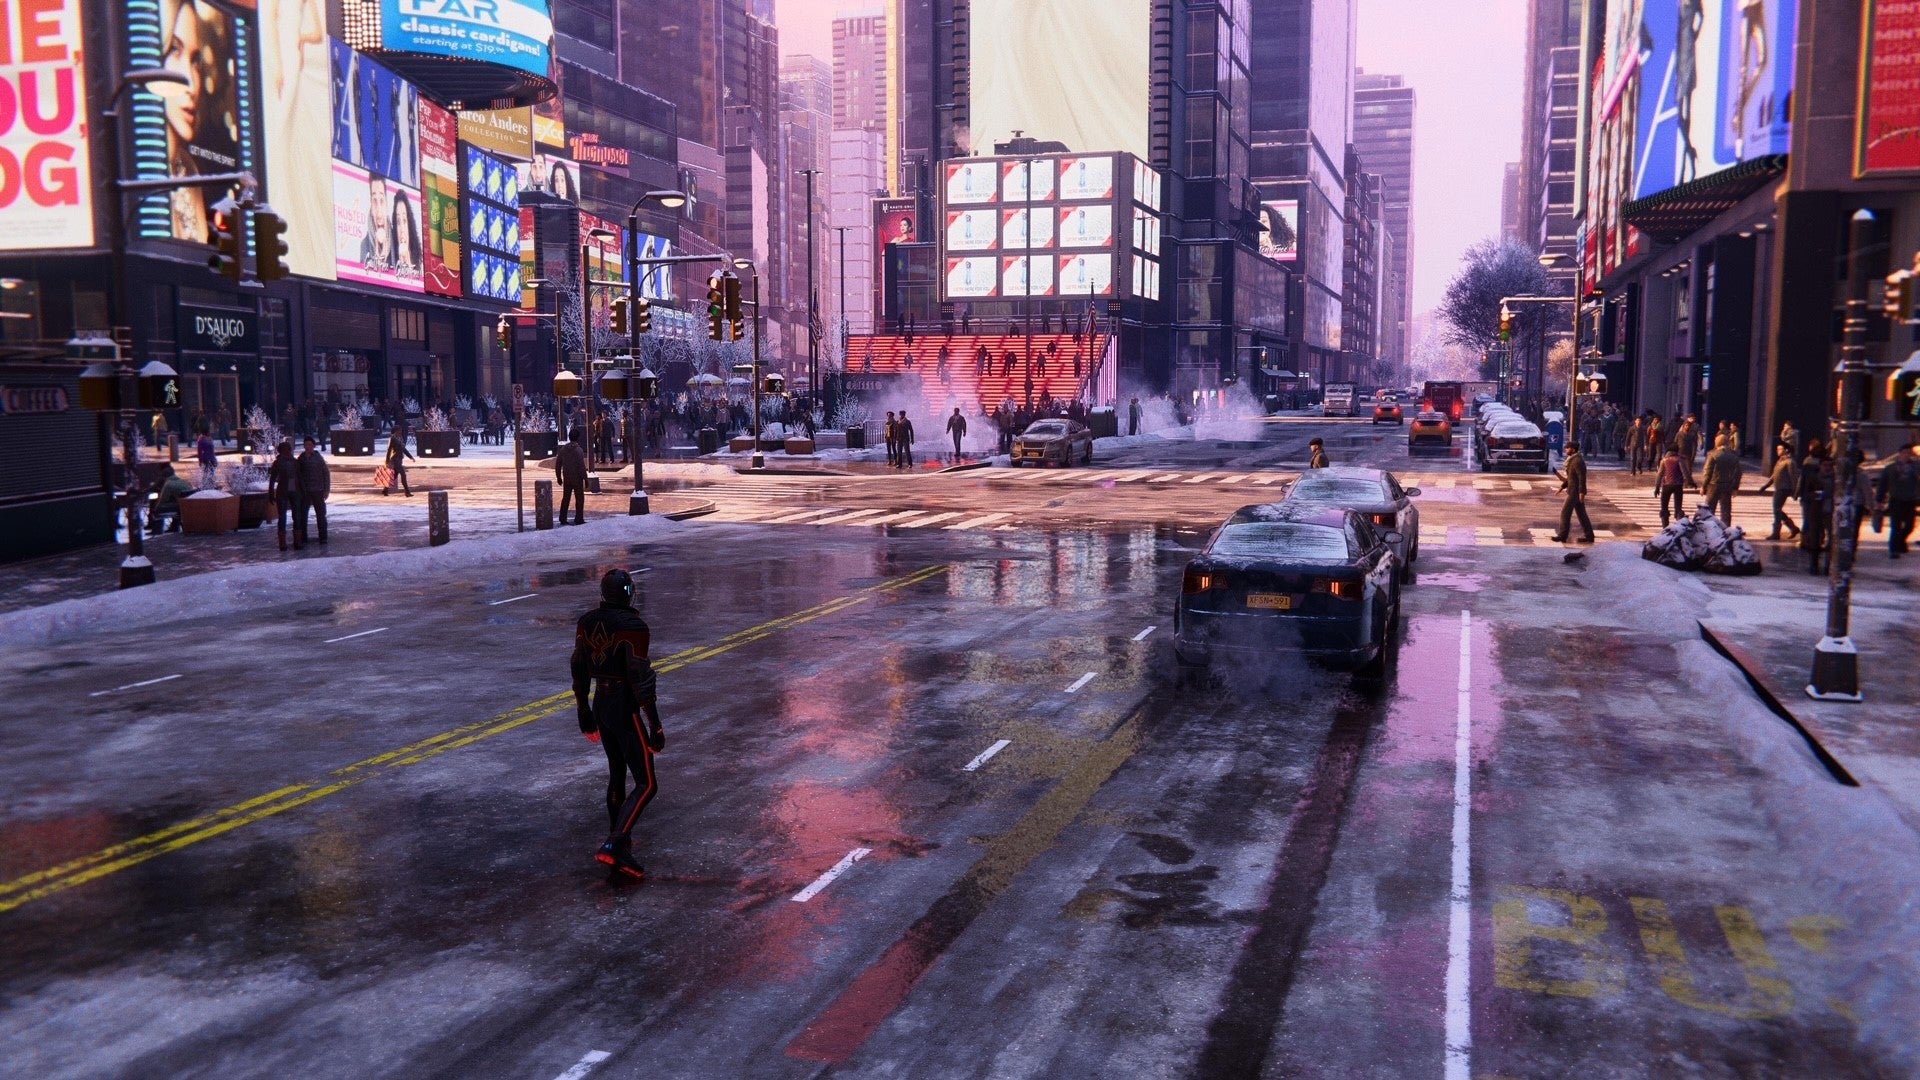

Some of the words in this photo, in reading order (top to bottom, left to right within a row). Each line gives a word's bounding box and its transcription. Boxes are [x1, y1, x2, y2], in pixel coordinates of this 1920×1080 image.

[401, 17, 466, 38] classic
[469, 31, 541, 57] cardigans!
[412, 37, 458, 50] starting
[461, 43, 473, 51] at
[464, 124, 514, 144] COLLECTION
[490, 111, 529, 136] Anders
[196, 315, 245, 338] D'SALIGO
